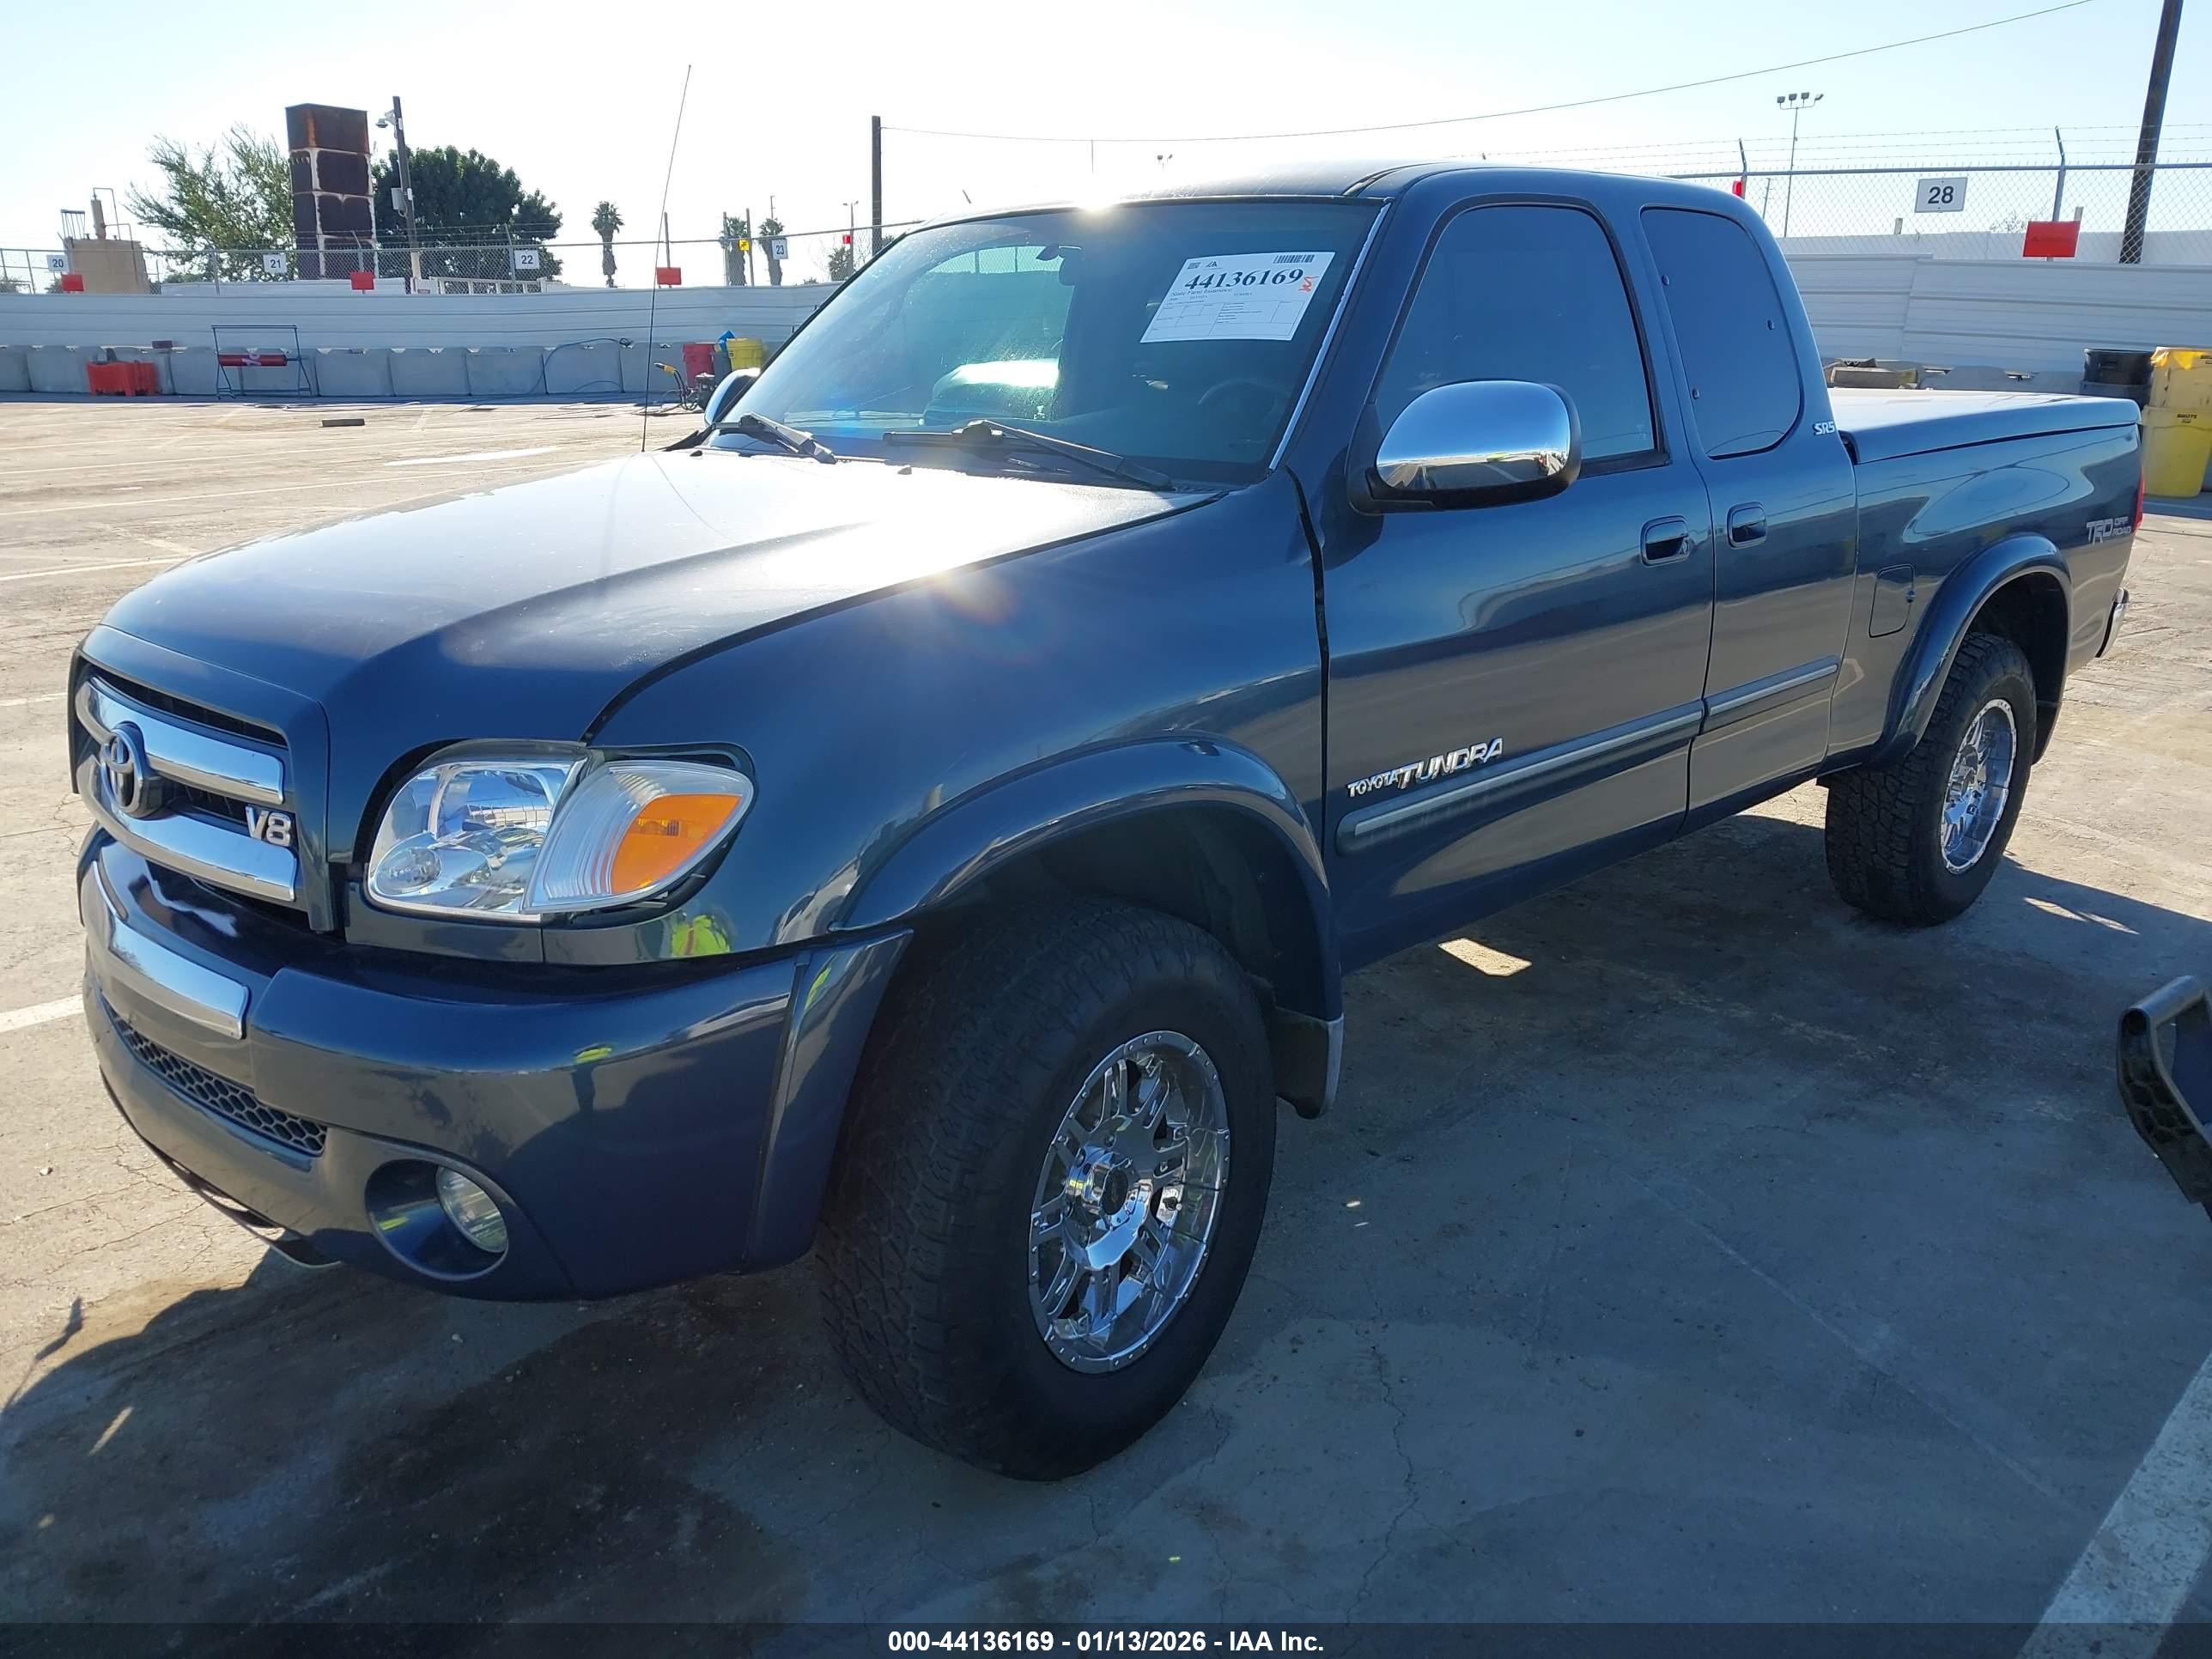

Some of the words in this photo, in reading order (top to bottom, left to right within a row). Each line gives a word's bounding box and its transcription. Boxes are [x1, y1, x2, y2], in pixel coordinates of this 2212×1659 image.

[1927, 185, 1954, 204] 28
[775, 245, 785, 255] 23
[52, 258, 64, 268] 20
[270, 258, 281, 269] 21
[520, 254, 534, 264] 22
[1184, 268, 1304, 290] 44136169
[1813, 421, 1836, 435] SR5
[2086, 518, 2113, 545] TRD
[1346, 769, 1399, 798] TOYOTA
[1398, 738, 1503, 790] TUNDRA
[245, 805, 292, 847] V8
